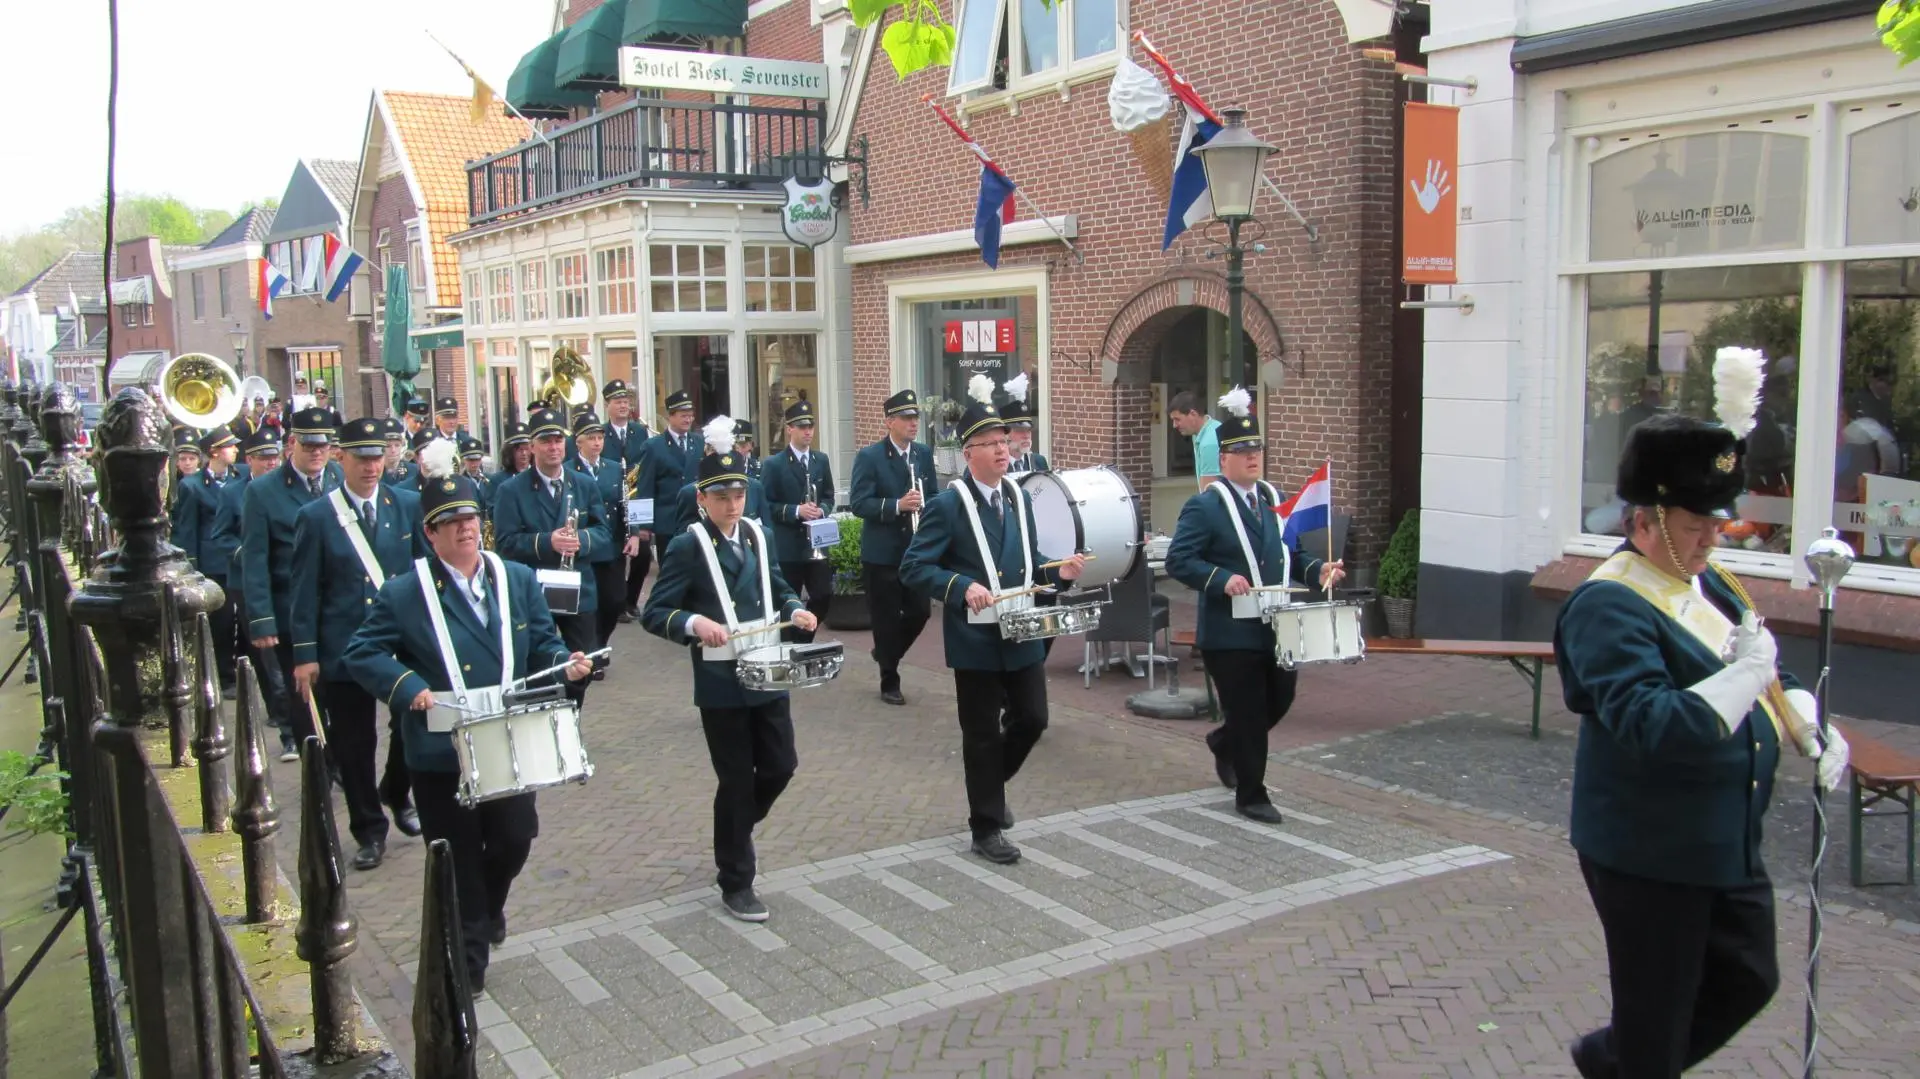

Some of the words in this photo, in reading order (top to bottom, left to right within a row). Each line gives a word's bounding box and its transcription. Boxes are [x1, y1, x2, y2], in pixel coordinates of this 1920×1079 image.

[633, 55, 680, 78] Hotel
[688, 60, 733, 82] Rest.
[741, 65, 821, 89] Sevenster
[789, 203, 832, 223] Grolsch
[949, 327, 1010, 345] ANNE
